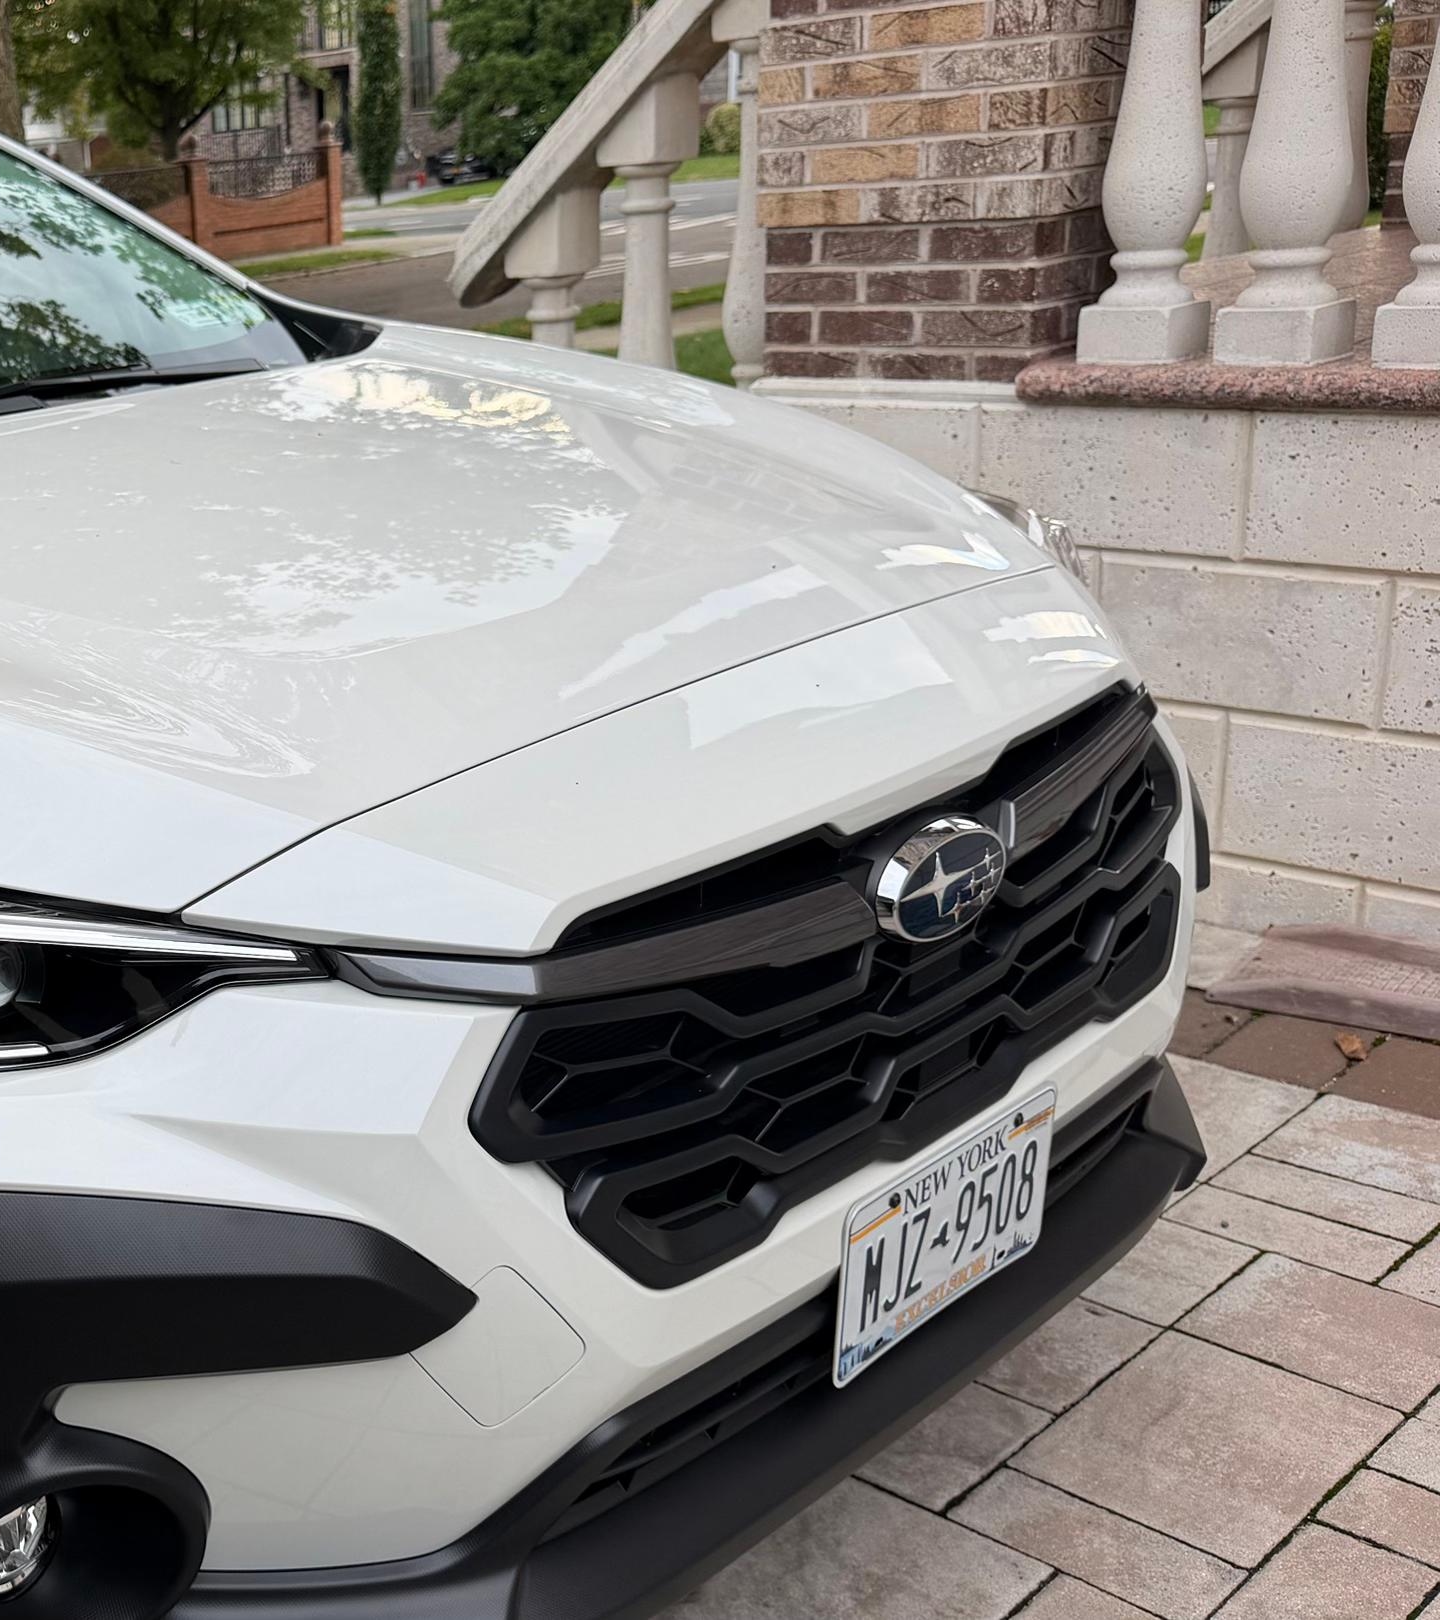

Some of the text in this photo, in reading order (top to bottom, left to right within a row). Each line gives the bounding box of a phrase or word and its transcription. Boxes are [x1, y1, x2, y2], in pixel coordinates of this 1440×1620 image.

[903, 1125, 1008, 1215] NEW YORK
[952, 1139, 1038, 1264] 9508
[895, 1253, 987, 1335] EXCELSIOR
